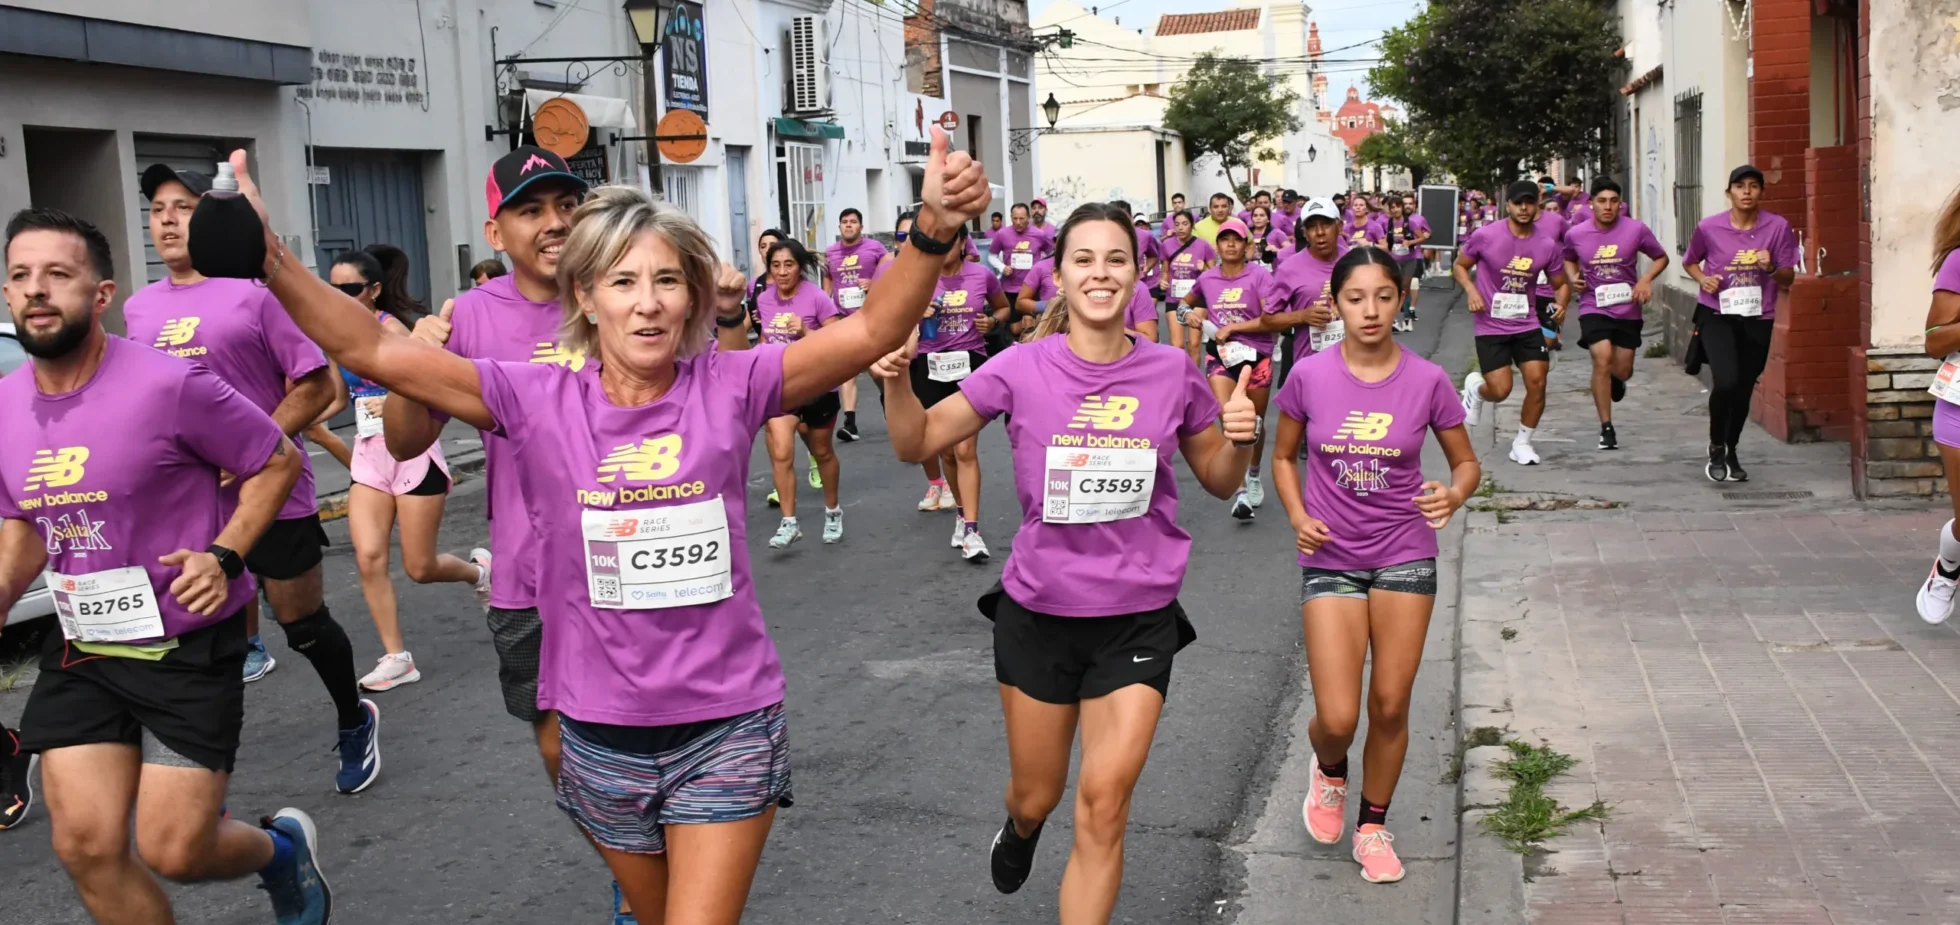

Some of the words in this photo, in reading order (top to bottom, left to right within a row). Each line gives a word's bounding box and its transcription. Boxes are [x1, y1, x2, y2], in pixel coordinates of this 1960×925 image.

[670, 36, 699, 72] NS
[672, 73, 699, 92] TIENDA
[1734, 298, 1759, 306] B2846
[940, 362, 965, 371] C3521
[1052, 434, 1084, 446] new
[1087, 433, 1151, 449] balance
[1321, 443, 1345, 453] new
[1349, 443, 1401, 457] balance
[1346, 469, 1377, 482] Salta
[577, 489, 616, 506] new
[620, 480, 705, 503] balance
[1050, 481, 1069, 491] 10K
[1079, 478, 1146, 493] C3593
[18, 497, 43, 511] new
[44, 490, 108, 506] balance
[1105, 506, 1140, 516] telecom
[640, 524, 671, 534] SERIES
[644, 517, 668, 526] RACE
[53, 522, 90, 542] Salta
[592, 555, 618, 568] 10K
[631, 541, 719, 570] C3592
[674, 582, 724, 598] telecom
[79, 593, 144, 615] B2765
[114, 623, 155, 636] telecom
